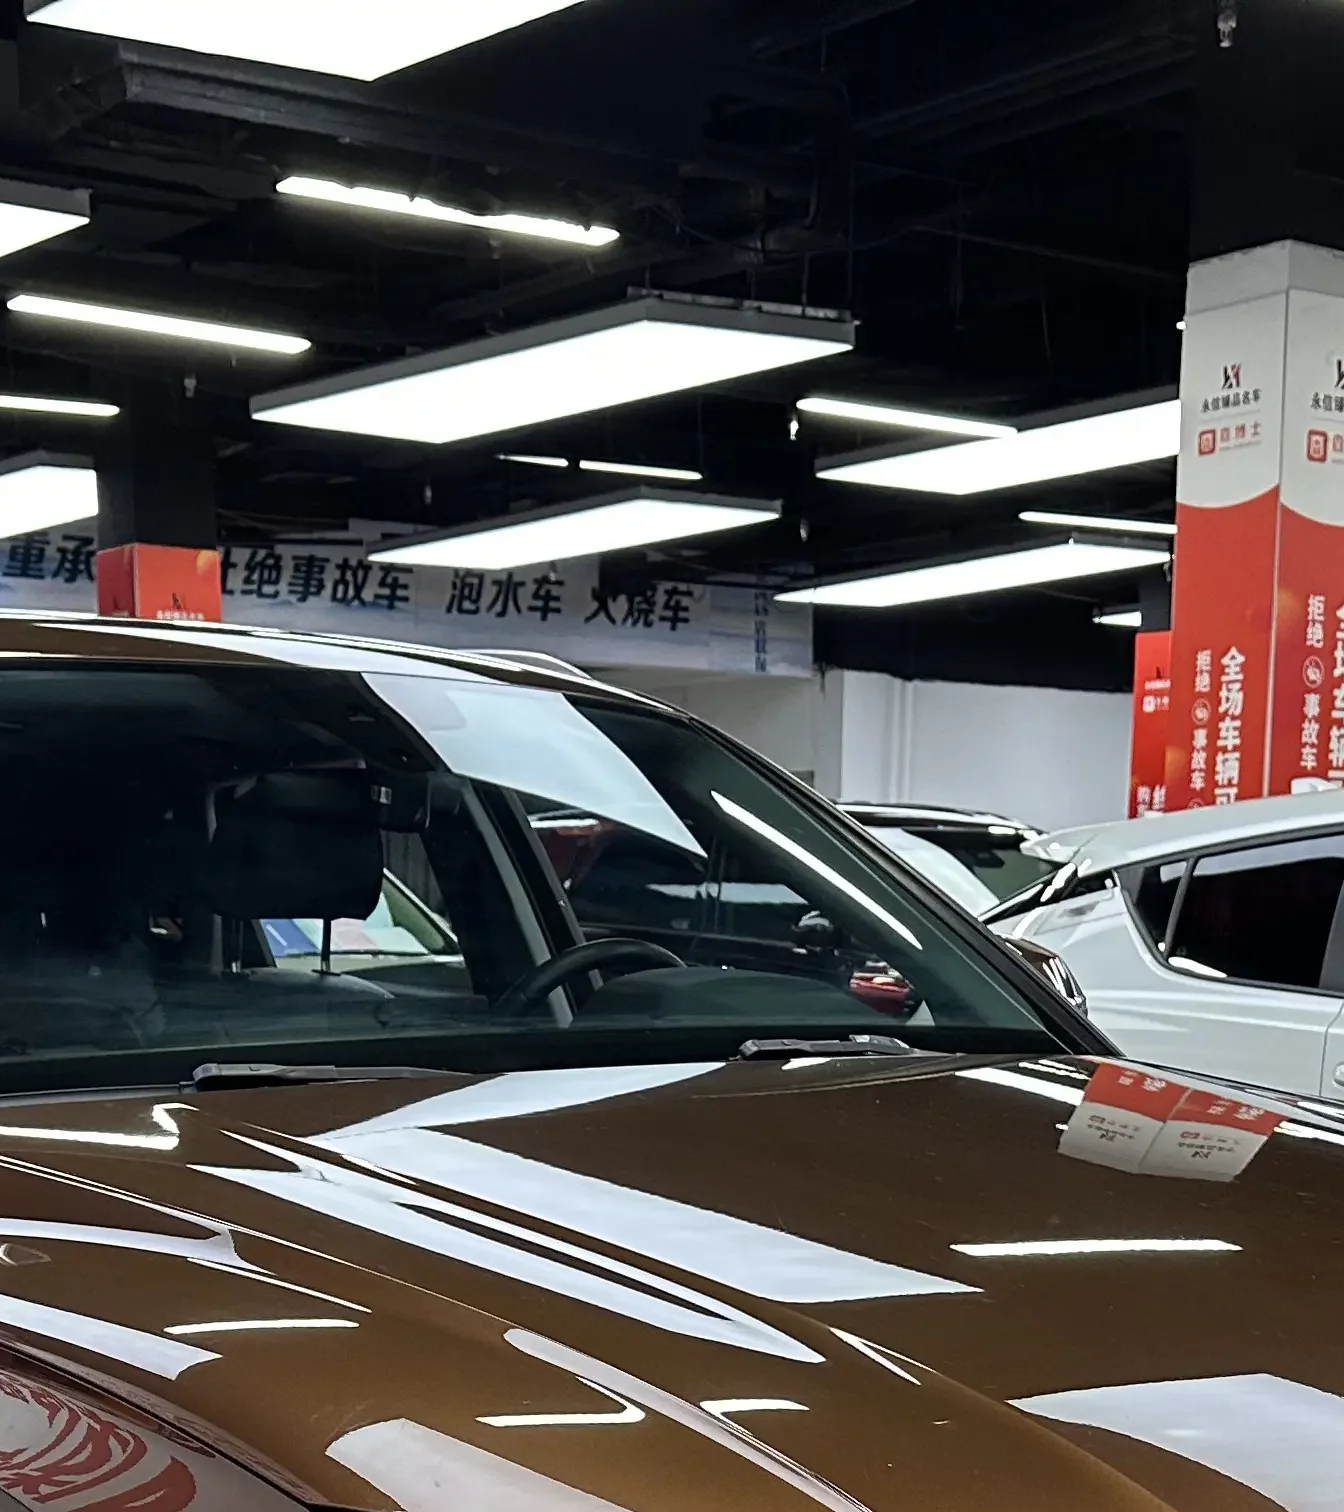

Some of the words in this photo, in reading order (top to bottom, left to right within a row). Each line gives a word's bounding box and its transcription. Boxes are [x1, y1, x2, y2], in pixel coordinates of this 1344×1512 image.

[445, 569, 566, 622] 泡水车
[583, 585, 694, 632] 火烧车
[1300, 693, 1321, 771] 事故车
